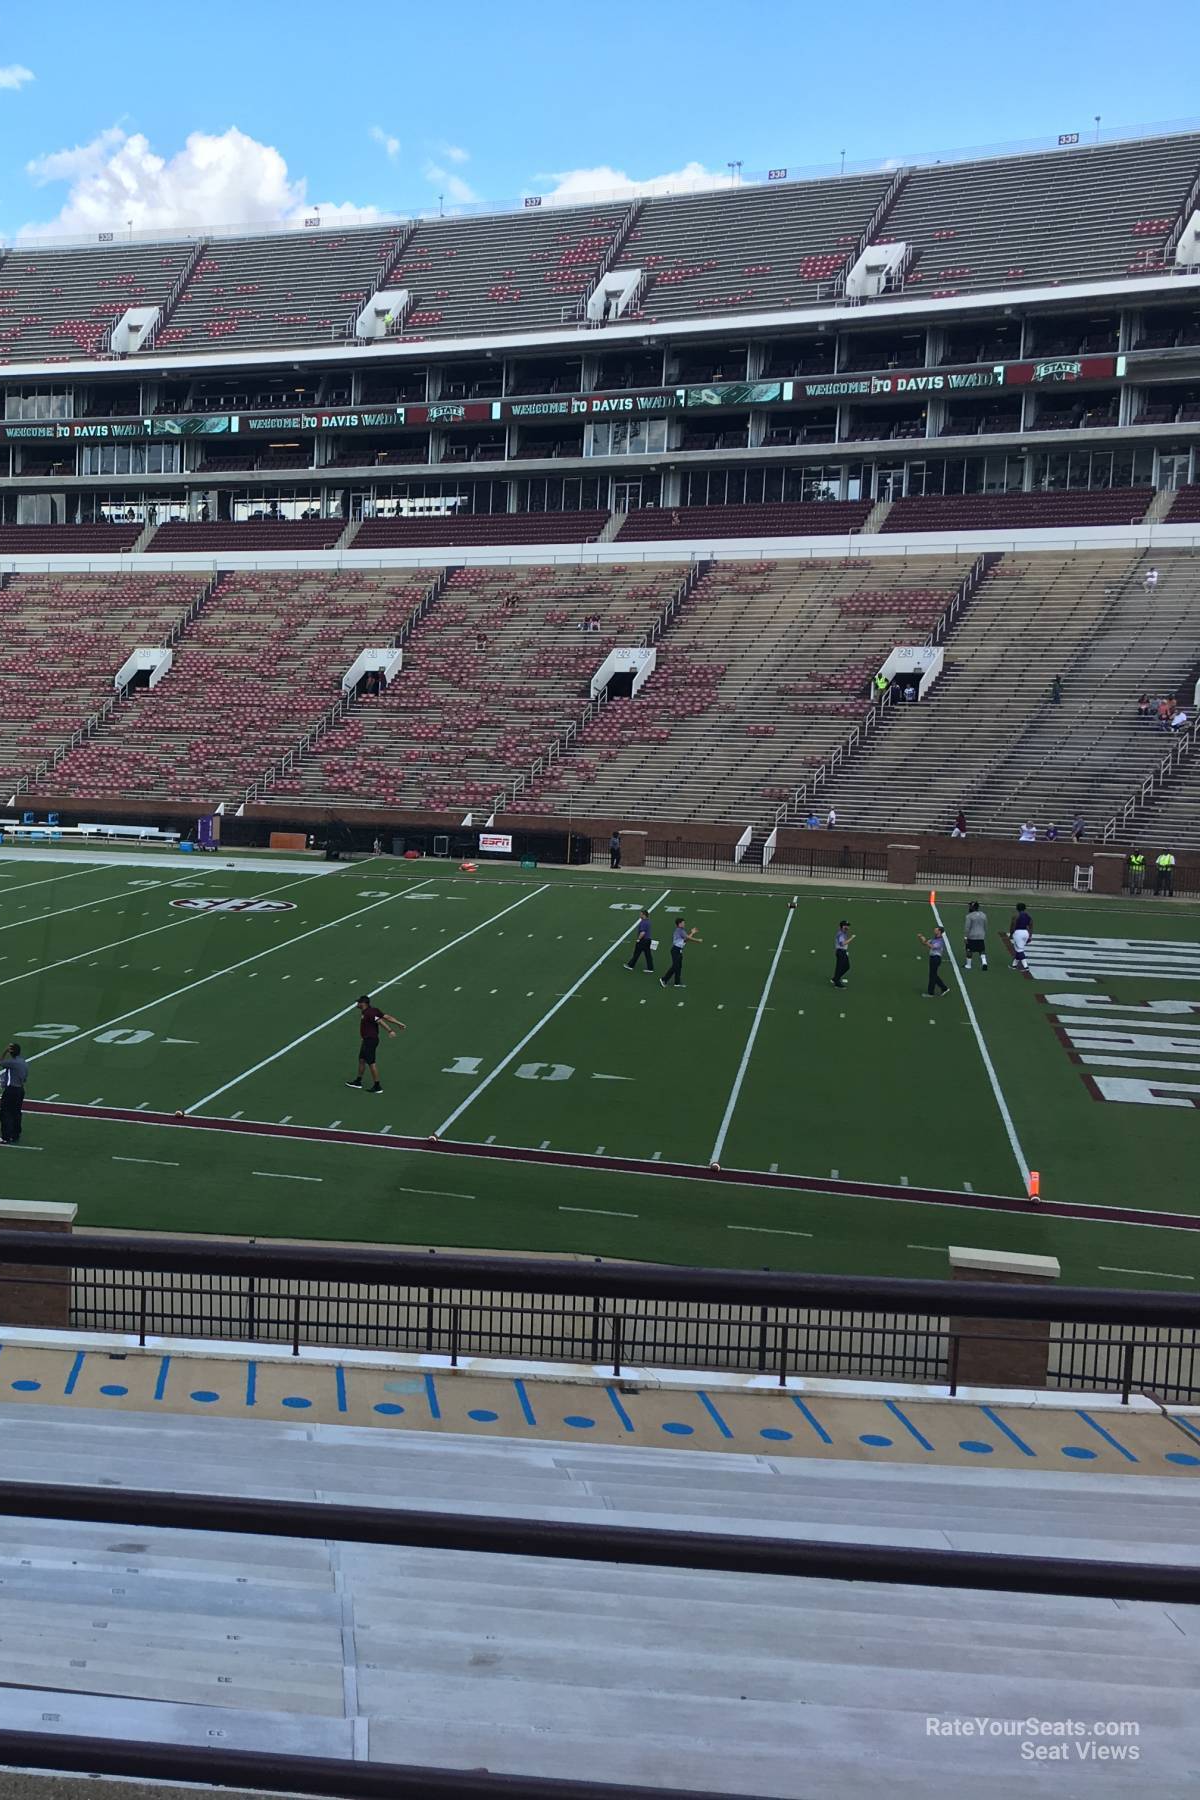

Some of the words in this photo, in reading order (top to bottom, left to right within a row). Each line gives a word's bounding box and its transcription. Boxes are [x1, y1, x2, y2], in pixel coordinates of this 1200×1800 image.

[1060, 134, 1077, 144] 339
[1040, 361, 1077, 376] STATE
[805, 381, 868, 396] WELCOME
[875, 380, 891, 392] TO
[897, 376, 943, 391] DAVIS
[512, 401, 568, 415] WELCOME
[573, 400, 587, 413] TO
[592, 399, 633, 411] DAVIS
[249, 418, 300, 429] WELCOME
[304, 417, 317, 428] TO
[322, 416, 358, 427] DAVIS
[6, 427, 52, 437] WELCOME
[58, 427, 69, 437] TO
[74, 426, 108, 437] DAVIS
[617, 649, 631, 658] 22
[899, 648, 913, 658] 23
[482, 838, 509, 846] ESPN
[176, 898, 286, 912] SEC
[14, 1023, 154, 1044] 20
[440, 1055, 578, 1081] 10
